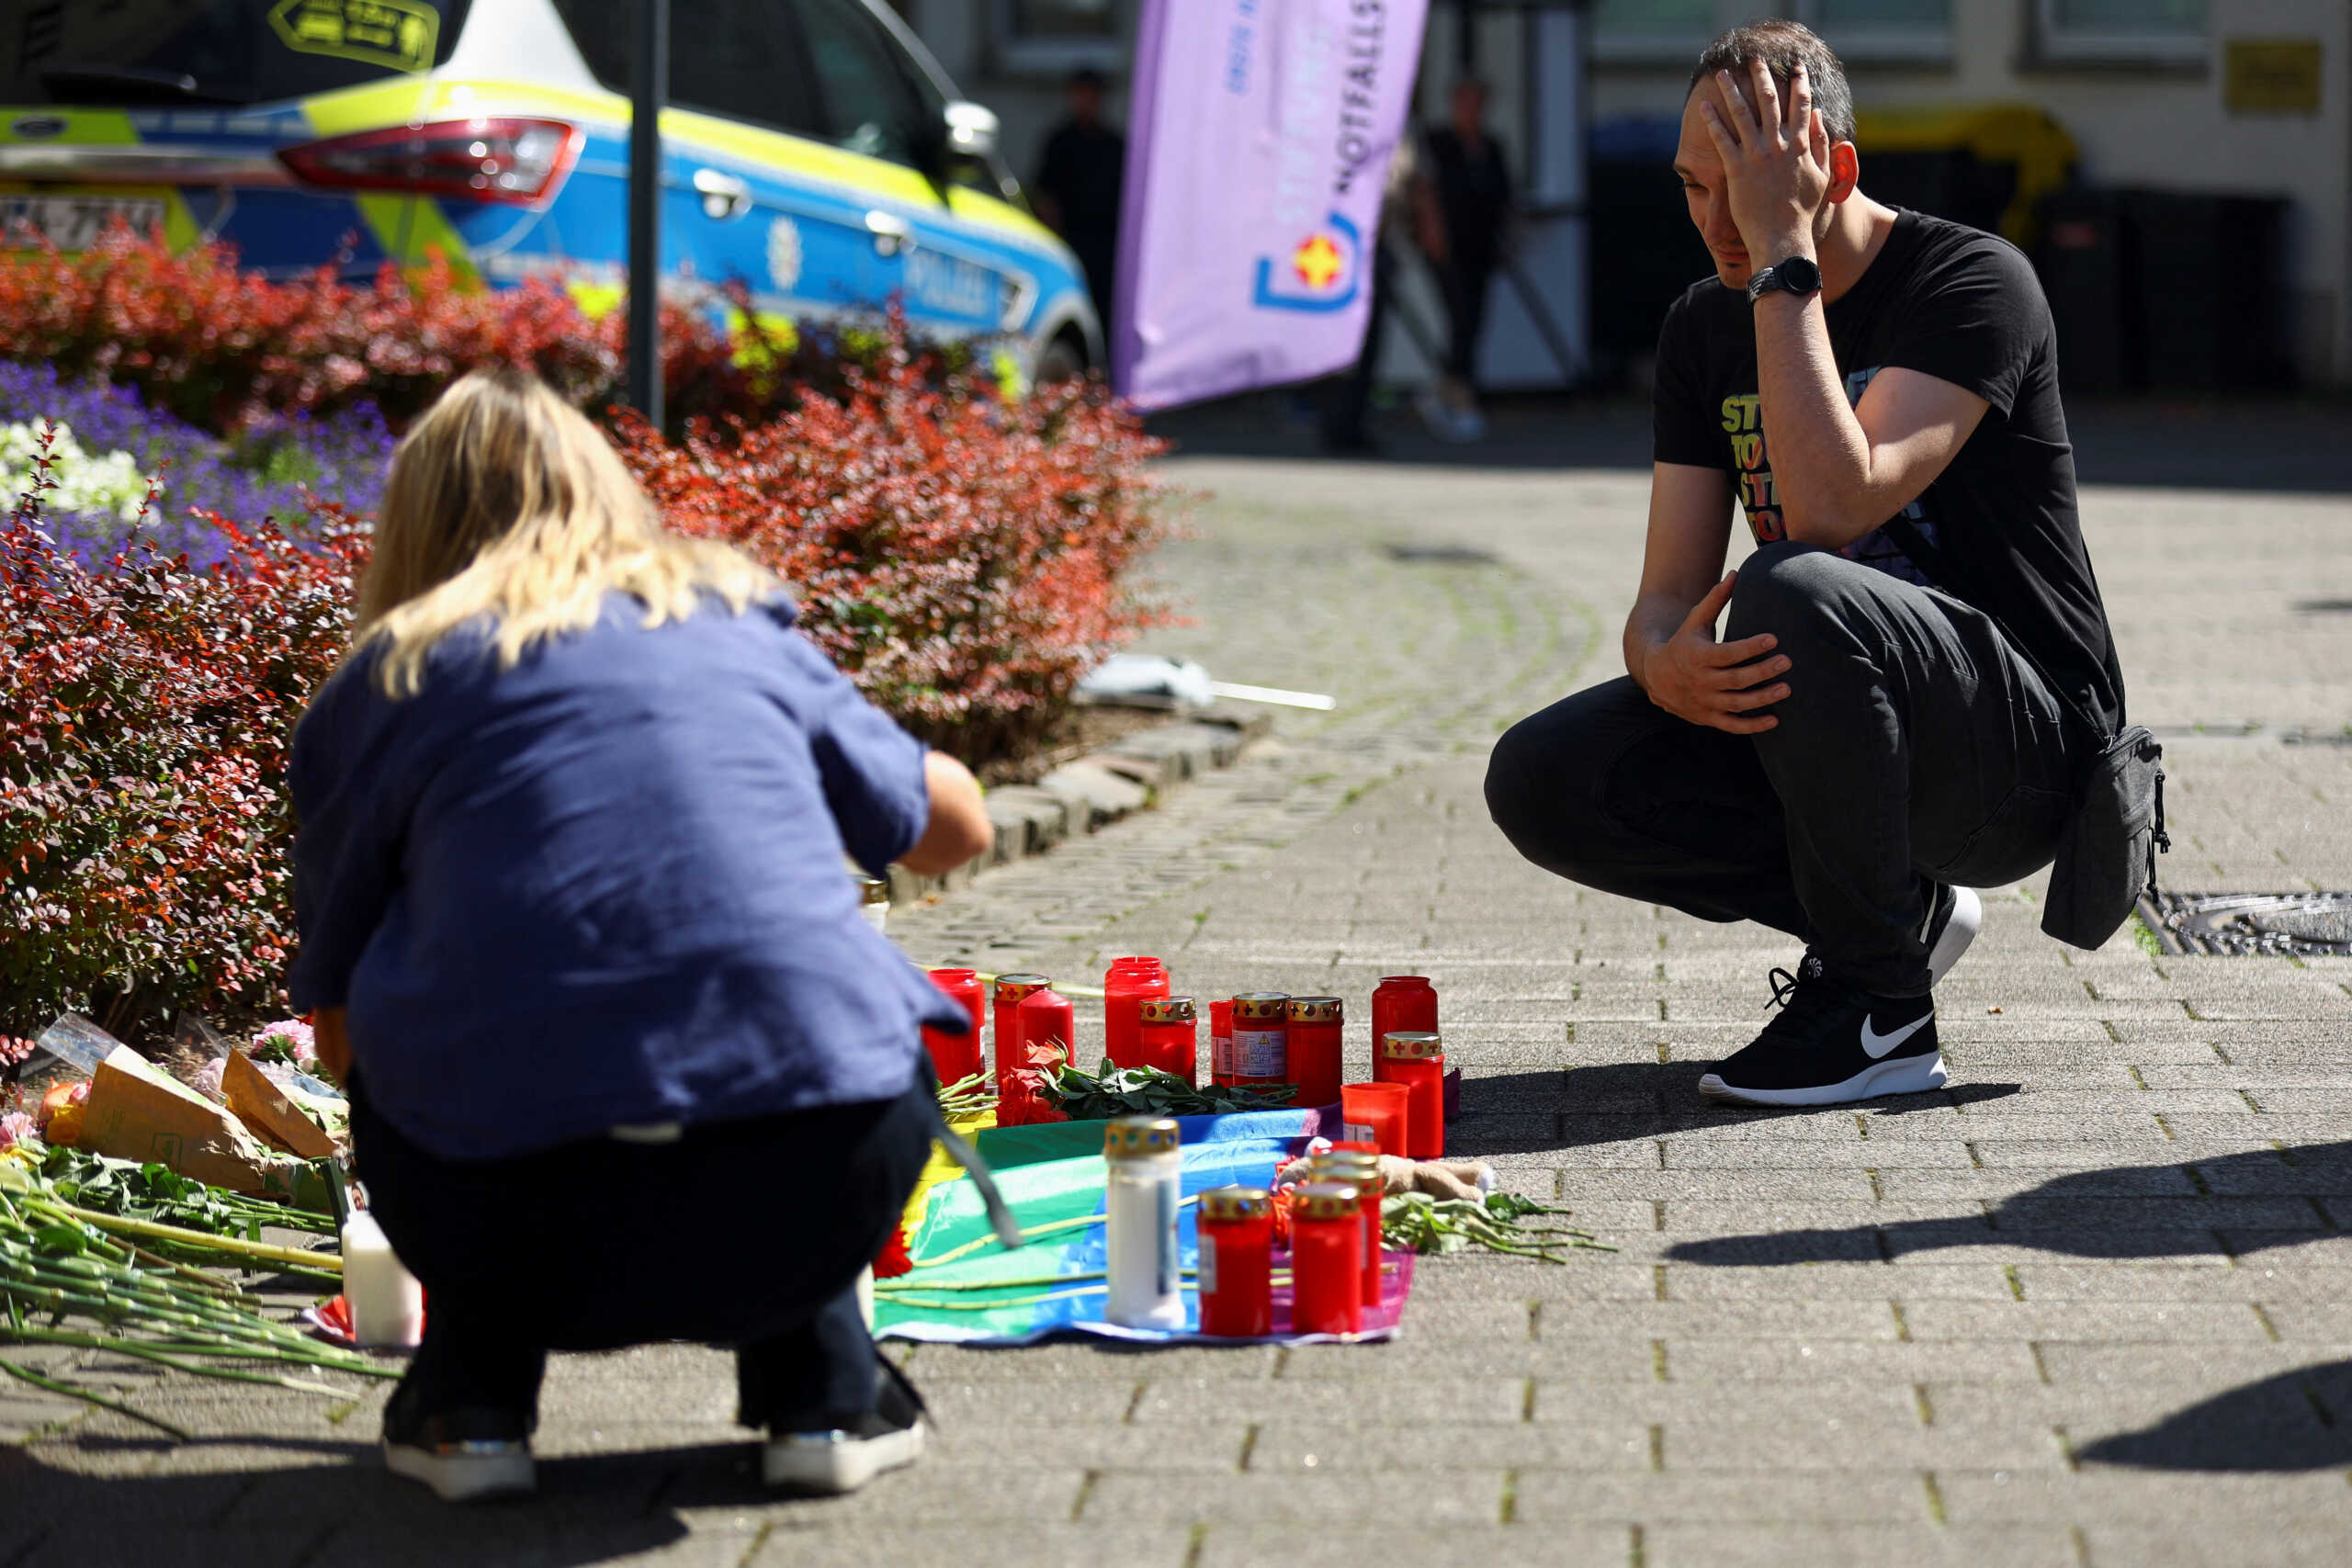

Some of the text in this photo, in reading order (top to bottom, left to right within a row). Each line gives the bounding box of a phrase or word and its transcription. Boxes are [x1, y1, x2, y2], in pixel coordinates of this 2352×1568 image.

[1721, 394, 1763, 433] ST
[1731, 434, 1768, 470] TO
[1747, 510, 1785, 542] TO
